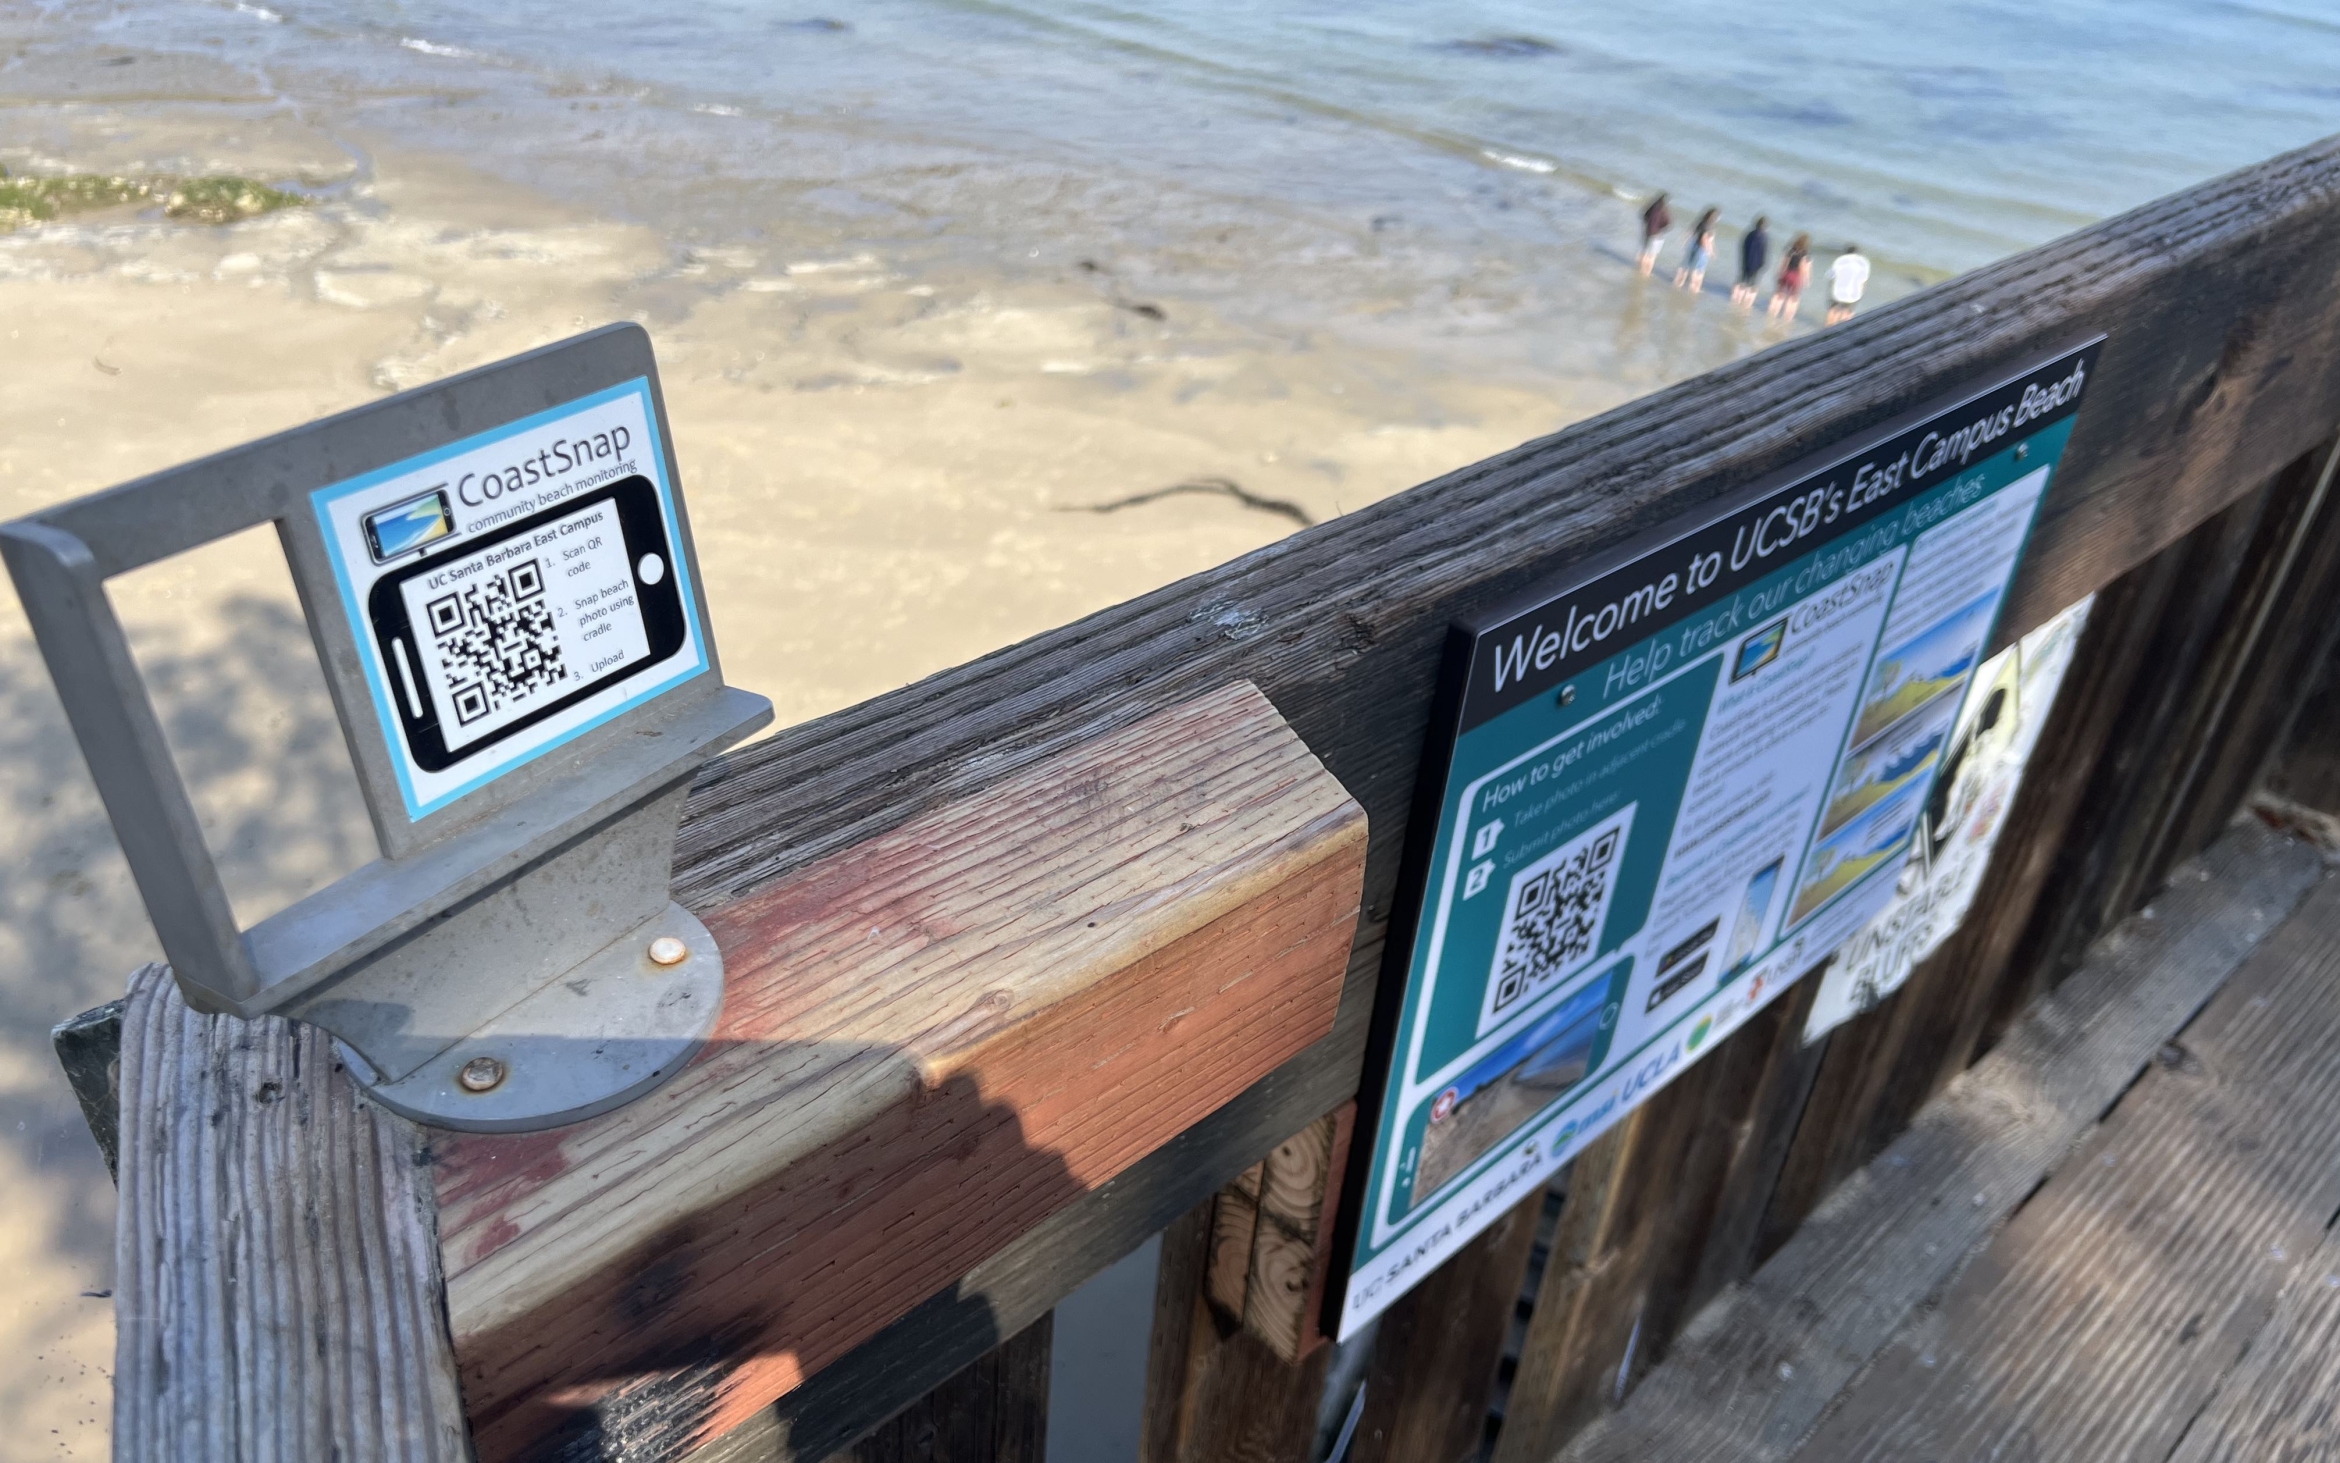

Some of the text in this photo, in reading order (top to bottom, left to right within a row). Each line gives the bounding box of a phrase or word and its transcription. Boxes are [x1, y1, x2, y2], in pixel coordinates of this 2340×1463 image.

[459, 426, 630, 507] CoastSnap
[468, 460, 637, 533] community beach monitoring
[428, 512, 604, 590] UC Santa Barbara East Campus
[545, 536, 603, 568] 1. Scan QR
[1495, 573, 1678, 692] Welcome
[1686, 552, 1721, 594] to
[1731, 481, 1845, 571] UCSB's
[1846, 451, 1910, 513] East
[1910, 404, 2014, 479] Campus
[2013, 358, 2085, 428] Beach
[557, 579, 629, 618] 2. Snap beach
[567, 561, 591, 577] code
[1603, 639, 1671, 699] Help
[1680, 594, 1744, 656] track
[1747, 575, 1794, 620] our
[1795, 519, 1899, 593] changing
[1901, 473, 1986, 535] beaches
[1791, 561, 1893, 635] CoastSnap
[580, 595, 634, 628] photo using
[583, 622, 612, 641] cradle
[574, 649, 624, 681] 3. Upload
[1482, 774, 1526, 812] How
[1530, 761, 1549, 786] to
[1552, 739, 1584, 779] get
[1514, 802, 1543, 827] Take
[1544, 781, 1583, 813] photo
[1503, 833, 1549, 868] Submit
[1622, 1040, 1682, 1102] UCLA
[1386, 1224, 1451, 1283] SANTA
[1456, 1152, 1542, 1229] BARBARA
